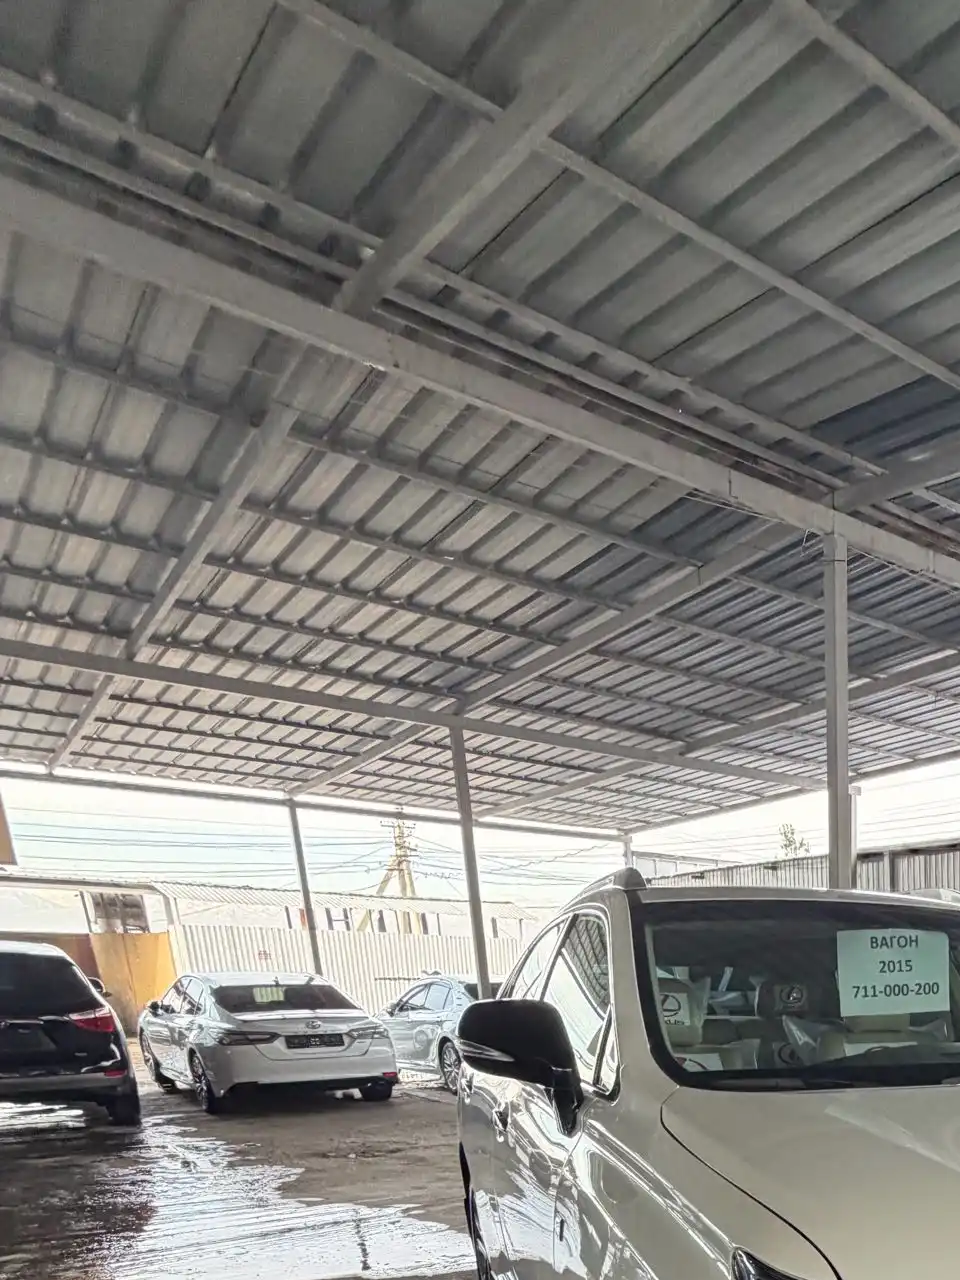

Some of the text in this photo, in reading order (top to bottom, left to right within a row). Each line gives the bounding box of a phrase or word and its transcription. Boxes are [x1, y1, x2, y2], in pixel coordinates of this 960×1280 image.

[869, 935, 919, 949] ВАГОН
[879, 960, 913, 973] 2015
[852, 982, 940, 999] 711-000-200
